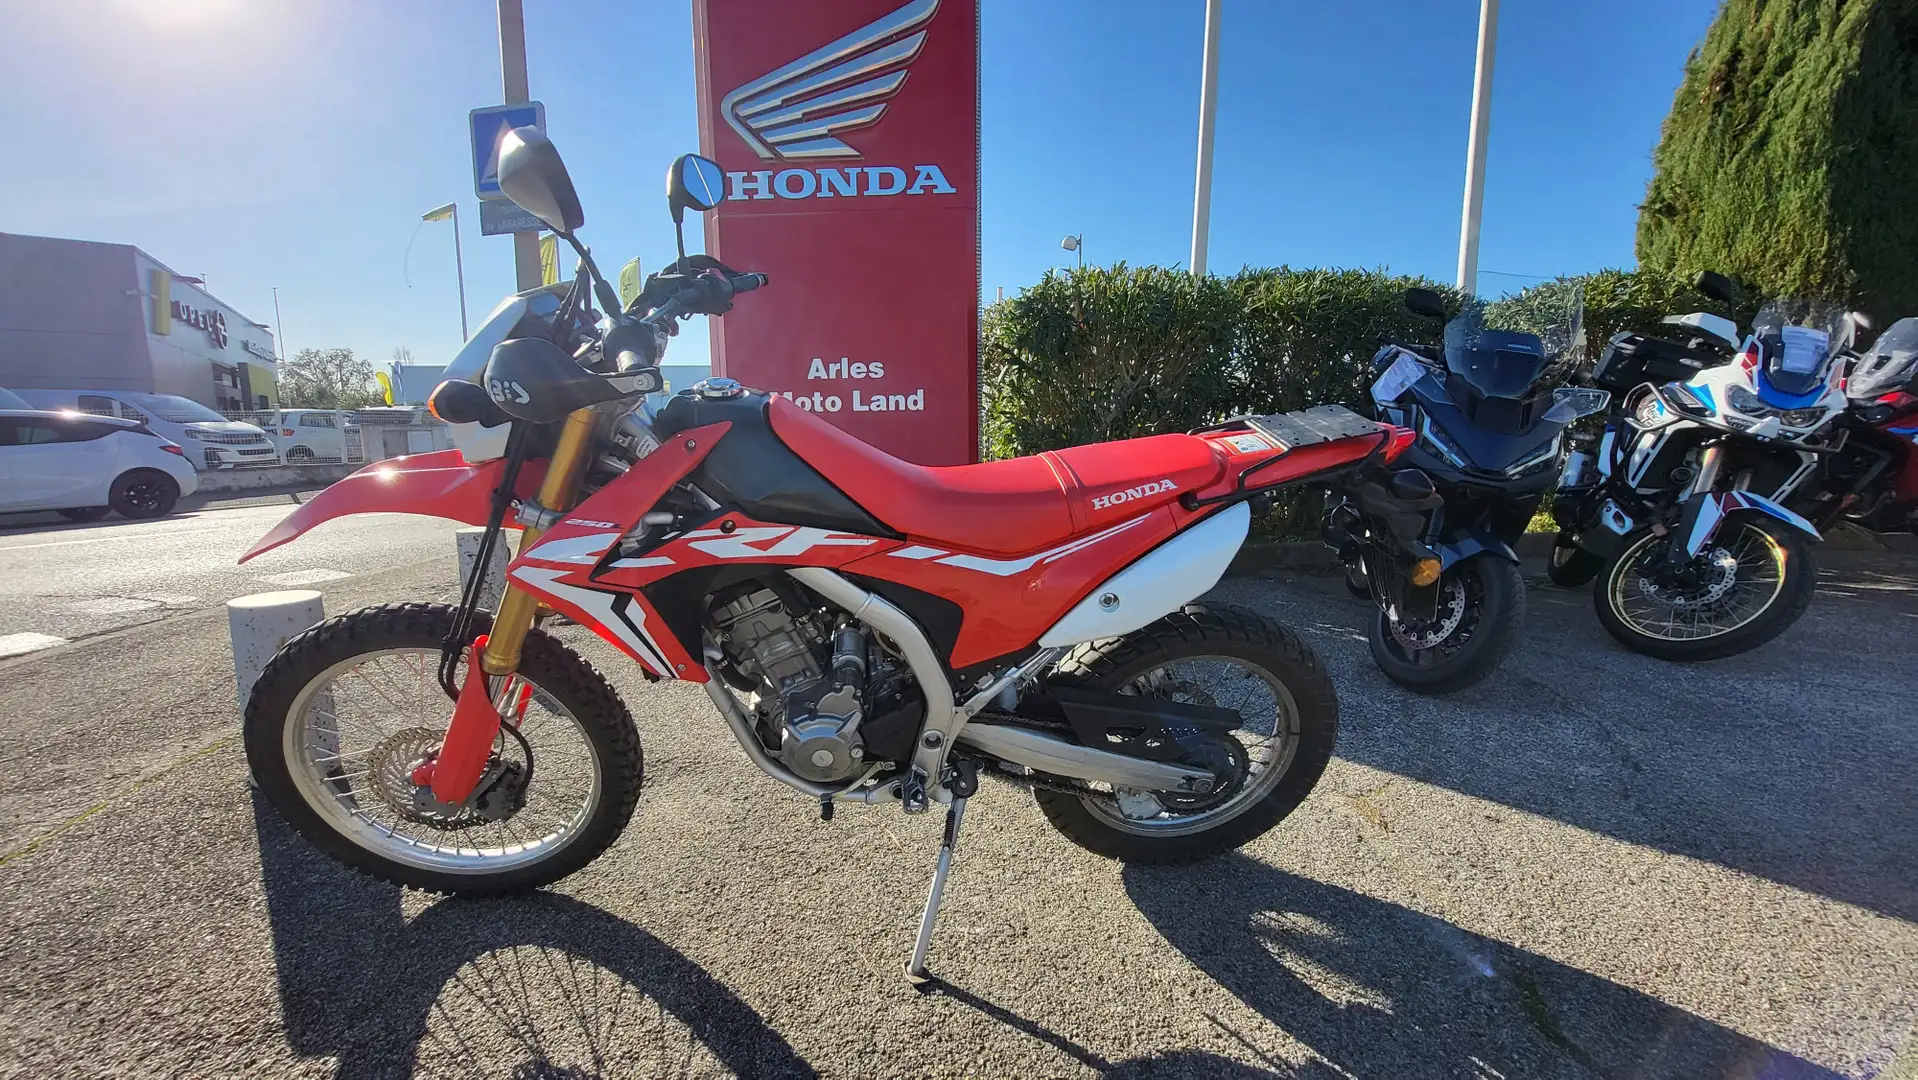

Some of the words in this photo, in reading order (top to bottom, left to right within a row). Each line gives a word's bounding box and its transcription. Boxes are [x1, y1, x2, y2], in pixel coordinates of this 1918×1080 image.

[726, 165, 957, 200] HONDA
[180, 303, 213, 333] OPEL
[807, 357, 885, 380] Arles
[852, 389, 925, 412] Land
[1091, 478, 1178, 510] HONDA
